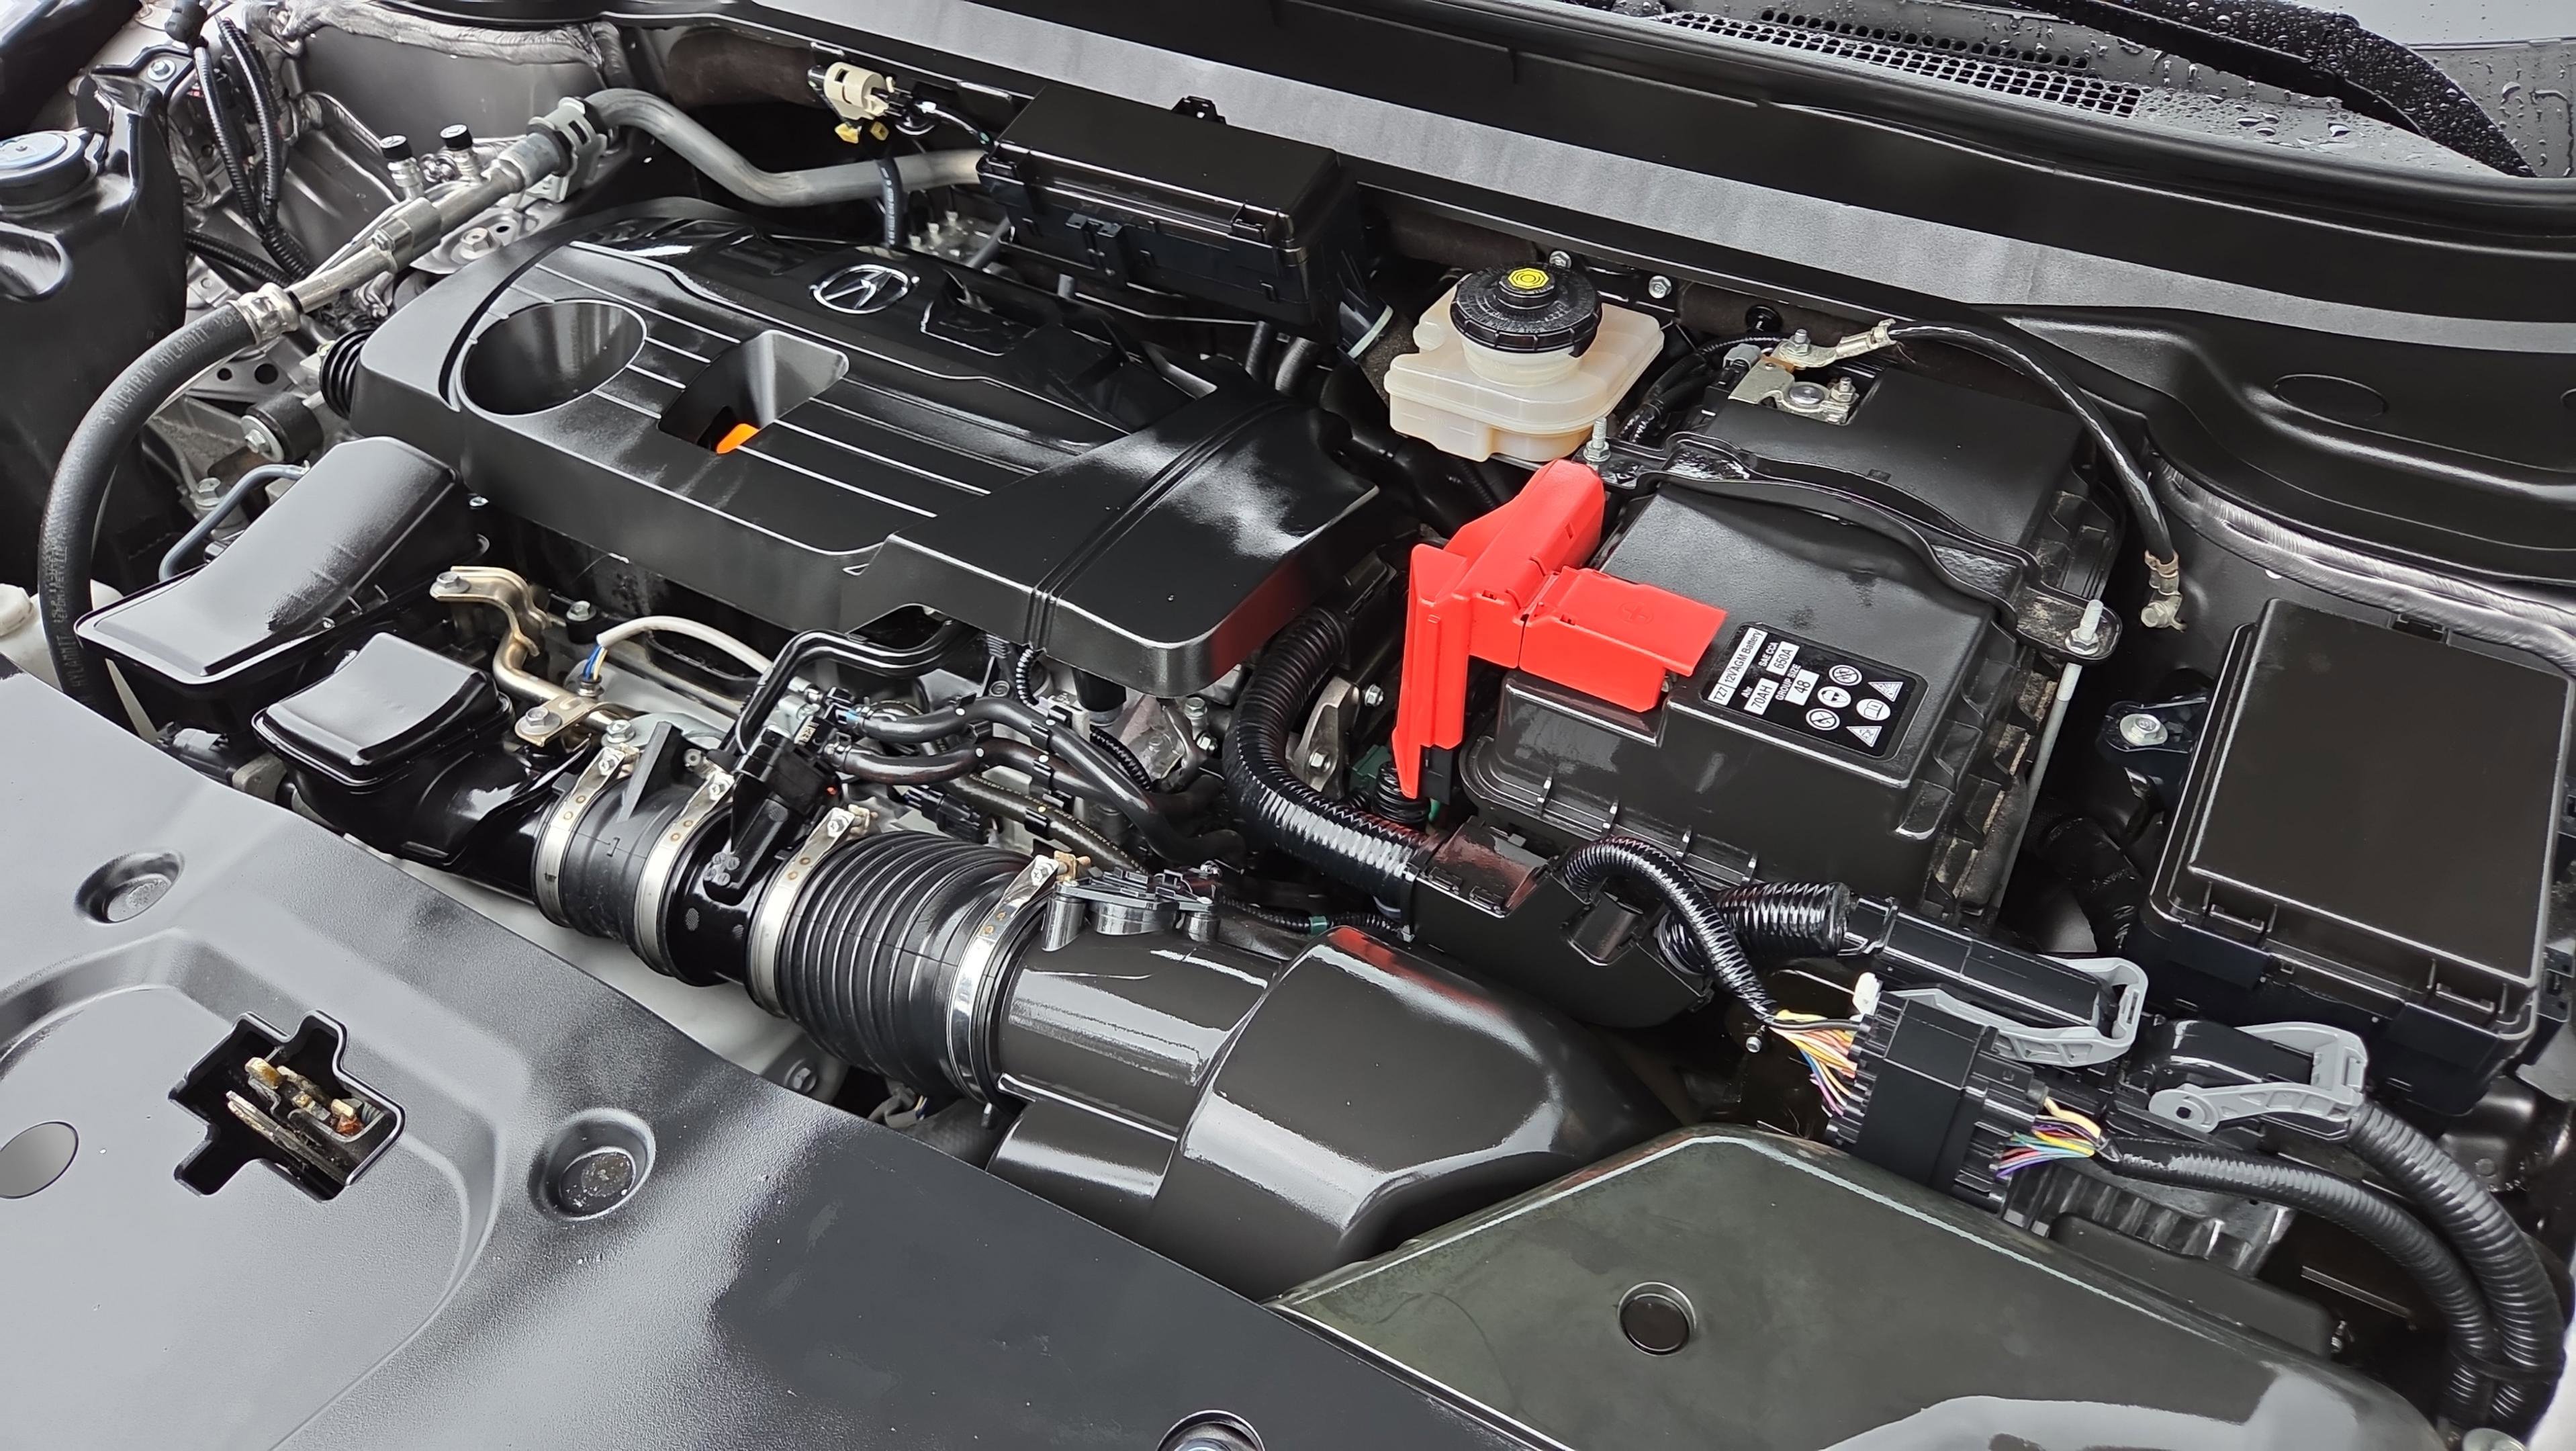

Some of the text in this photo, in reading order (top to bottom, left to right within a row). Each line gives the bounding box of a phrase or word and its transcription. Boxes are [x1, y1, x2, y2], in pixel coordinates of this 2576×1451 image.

[109, 365, 157, 414] NICHIRIN
[1713, 687, 1728, 701] TZ7
[1729, 654, 1748, 672] AGM
[1741, 631, 1763, 654] Battery
[1758, 642, 1779, 667] SAE CCA
[1774, 649, 1793, 669] 650A
[1775, 663, 1802, 701] GROUP SIZE
[1794, 680, 1811, 694] 48
[1751, 685, 1773, 709] 70AH
